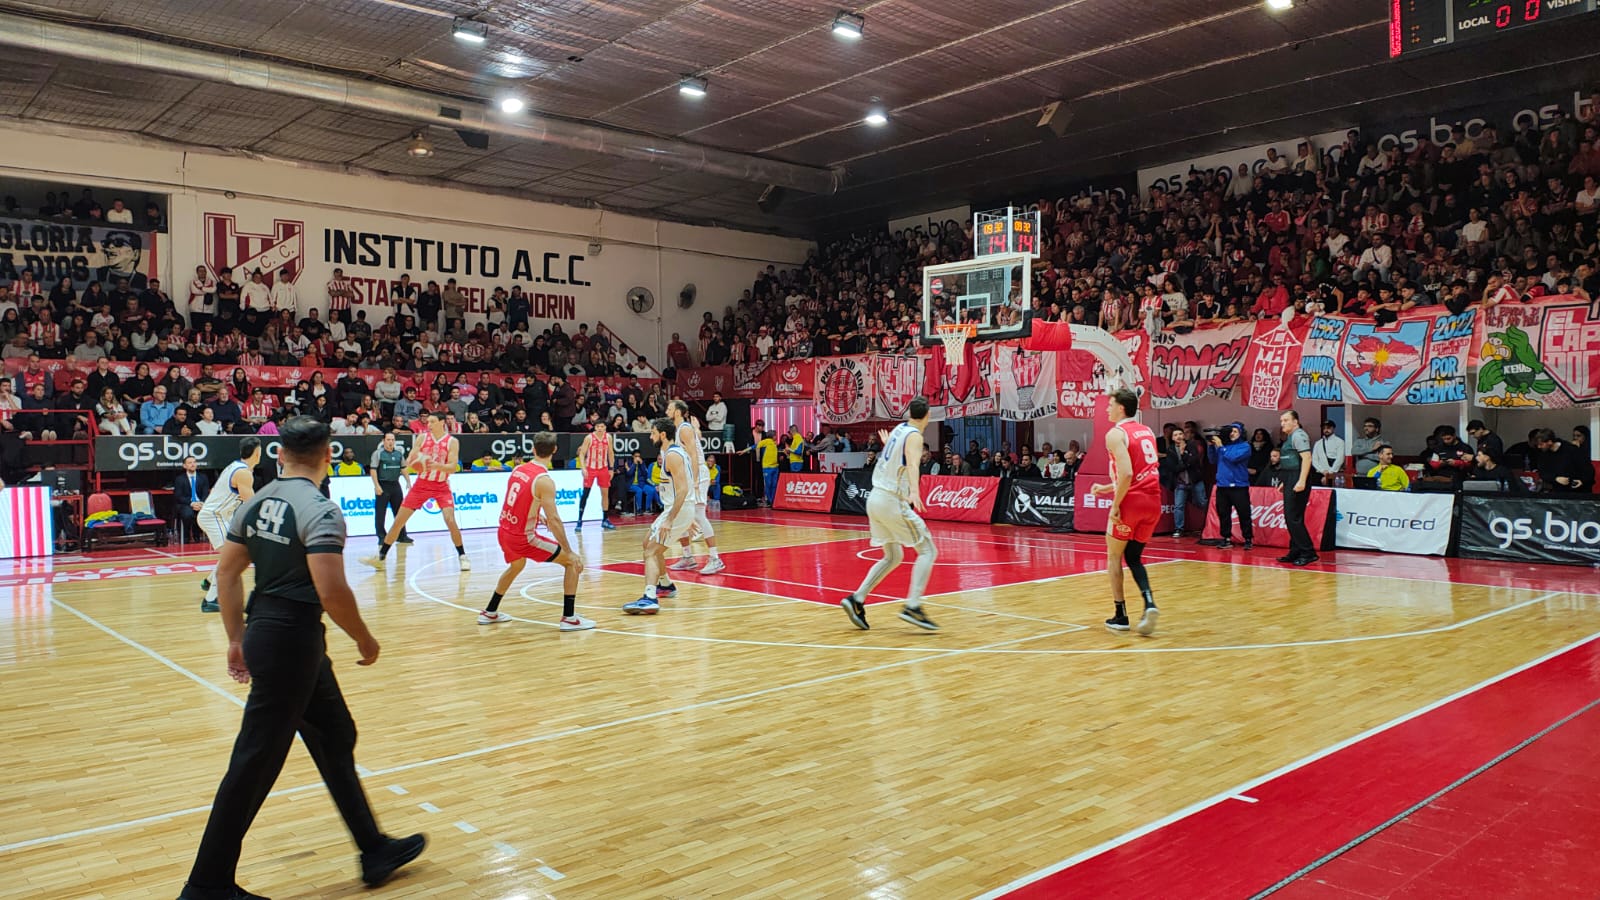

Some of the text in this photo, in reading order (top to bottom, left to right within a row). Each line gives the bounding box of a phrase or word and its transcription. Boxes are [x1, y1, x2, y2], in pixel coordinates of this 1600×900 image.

[1458, 15, 1490, 30] LOCAL
[1496, 5, 1511, 28] 0
[989, 234, 1033, 254] 14 14
[24, 254, 90, 282] DIOS
[324, 229, 591, 287] INSTITUTO A.C.C.
[1432, 308, 1477, 341] 2022
[1547, 310, 1582, 330] EL
[839, 358, 856, 371] AND
[1151, 335, 1251, 399] GOMEZ
[1302, 356, 1336, 375] HONOR
[1430, 356, 1458, 379] POR
[1297, 377, 1343, 401] GLORIA
[1407, 377, 1467, 404] SIEMPRE
[119, 435, 208, 470] gs.bio
[1141, 438, 1158, 465] 9
[507, 482, 521, 507] 6
[794, 481, 828, 496] ECCO
[341, 497, 376, 511] loter
[1034, 495, 1075, 507] VALLE
[256, 498, 289, 535] 94
[1346, 511, 1436, 531] Tecnored
[1489, 511, 1600, 549] gs.bio
